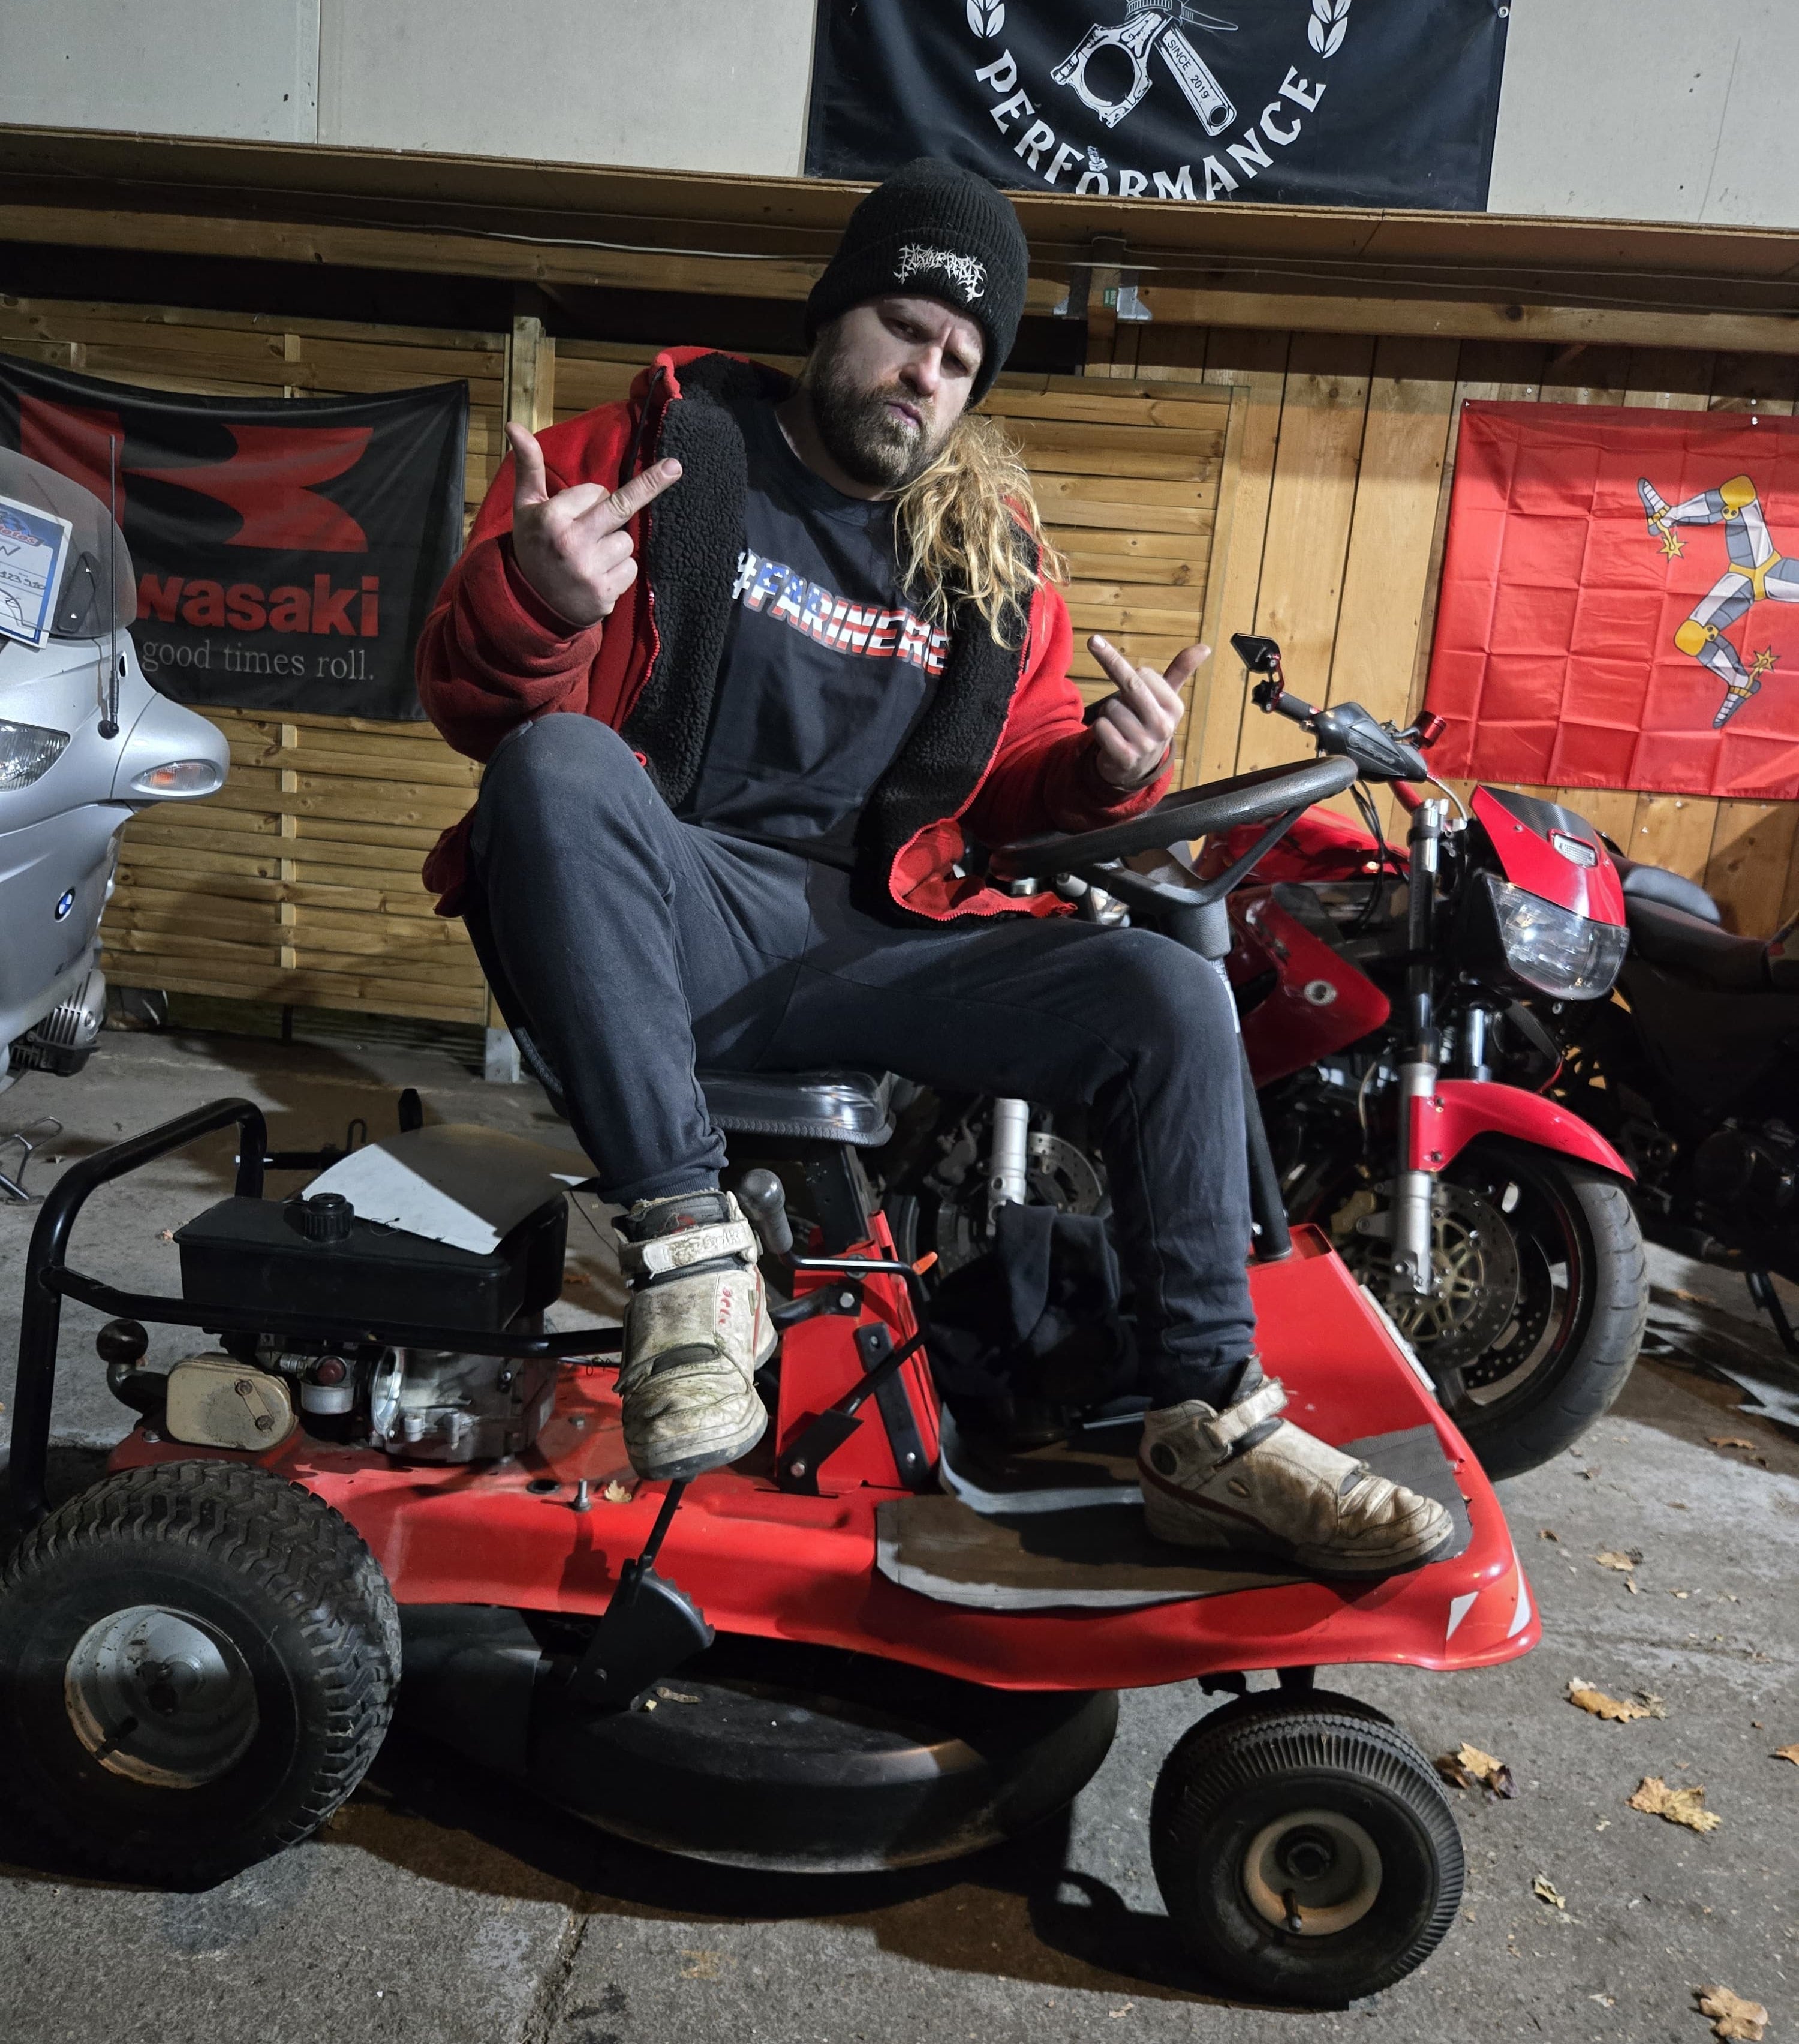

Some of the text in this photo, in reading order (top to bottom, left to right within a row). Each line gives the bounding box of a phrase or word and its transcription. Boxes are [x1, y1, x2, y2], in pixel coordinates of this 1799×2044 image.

[1167, 40, 1210, 100] SINCE 2019
[974, 49, 1326, 201] PERFORMANCE
[142, 639, 375, 681] good times roll.
